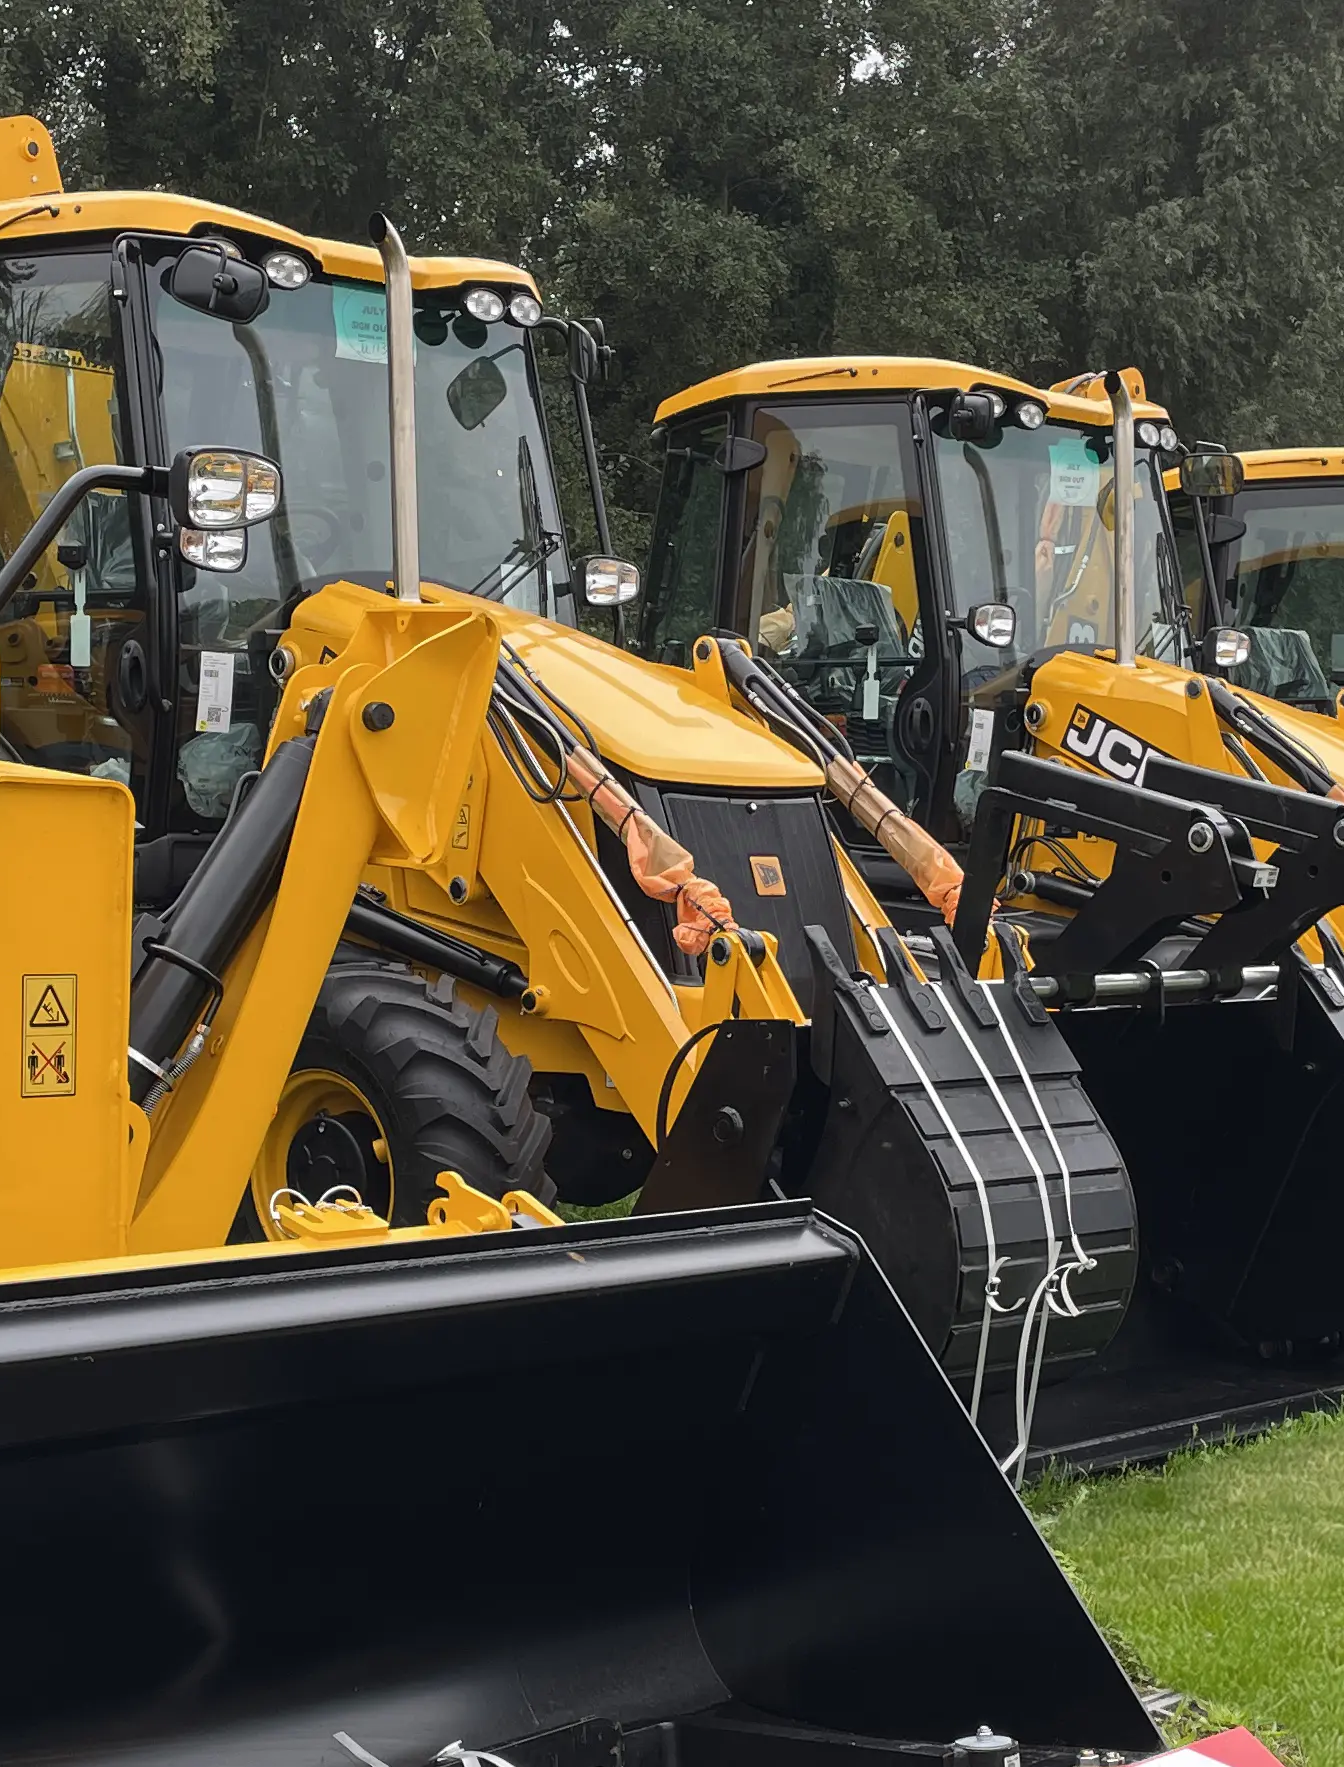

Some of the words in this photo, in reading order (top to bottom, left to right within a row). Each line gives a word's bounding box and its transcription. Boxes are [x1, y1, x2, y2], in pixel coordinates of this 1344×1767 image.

[361, 305, 386, 316] JULY
[372, 323, 387, 333] OU
[1066, 718, 1157, 788] JC
